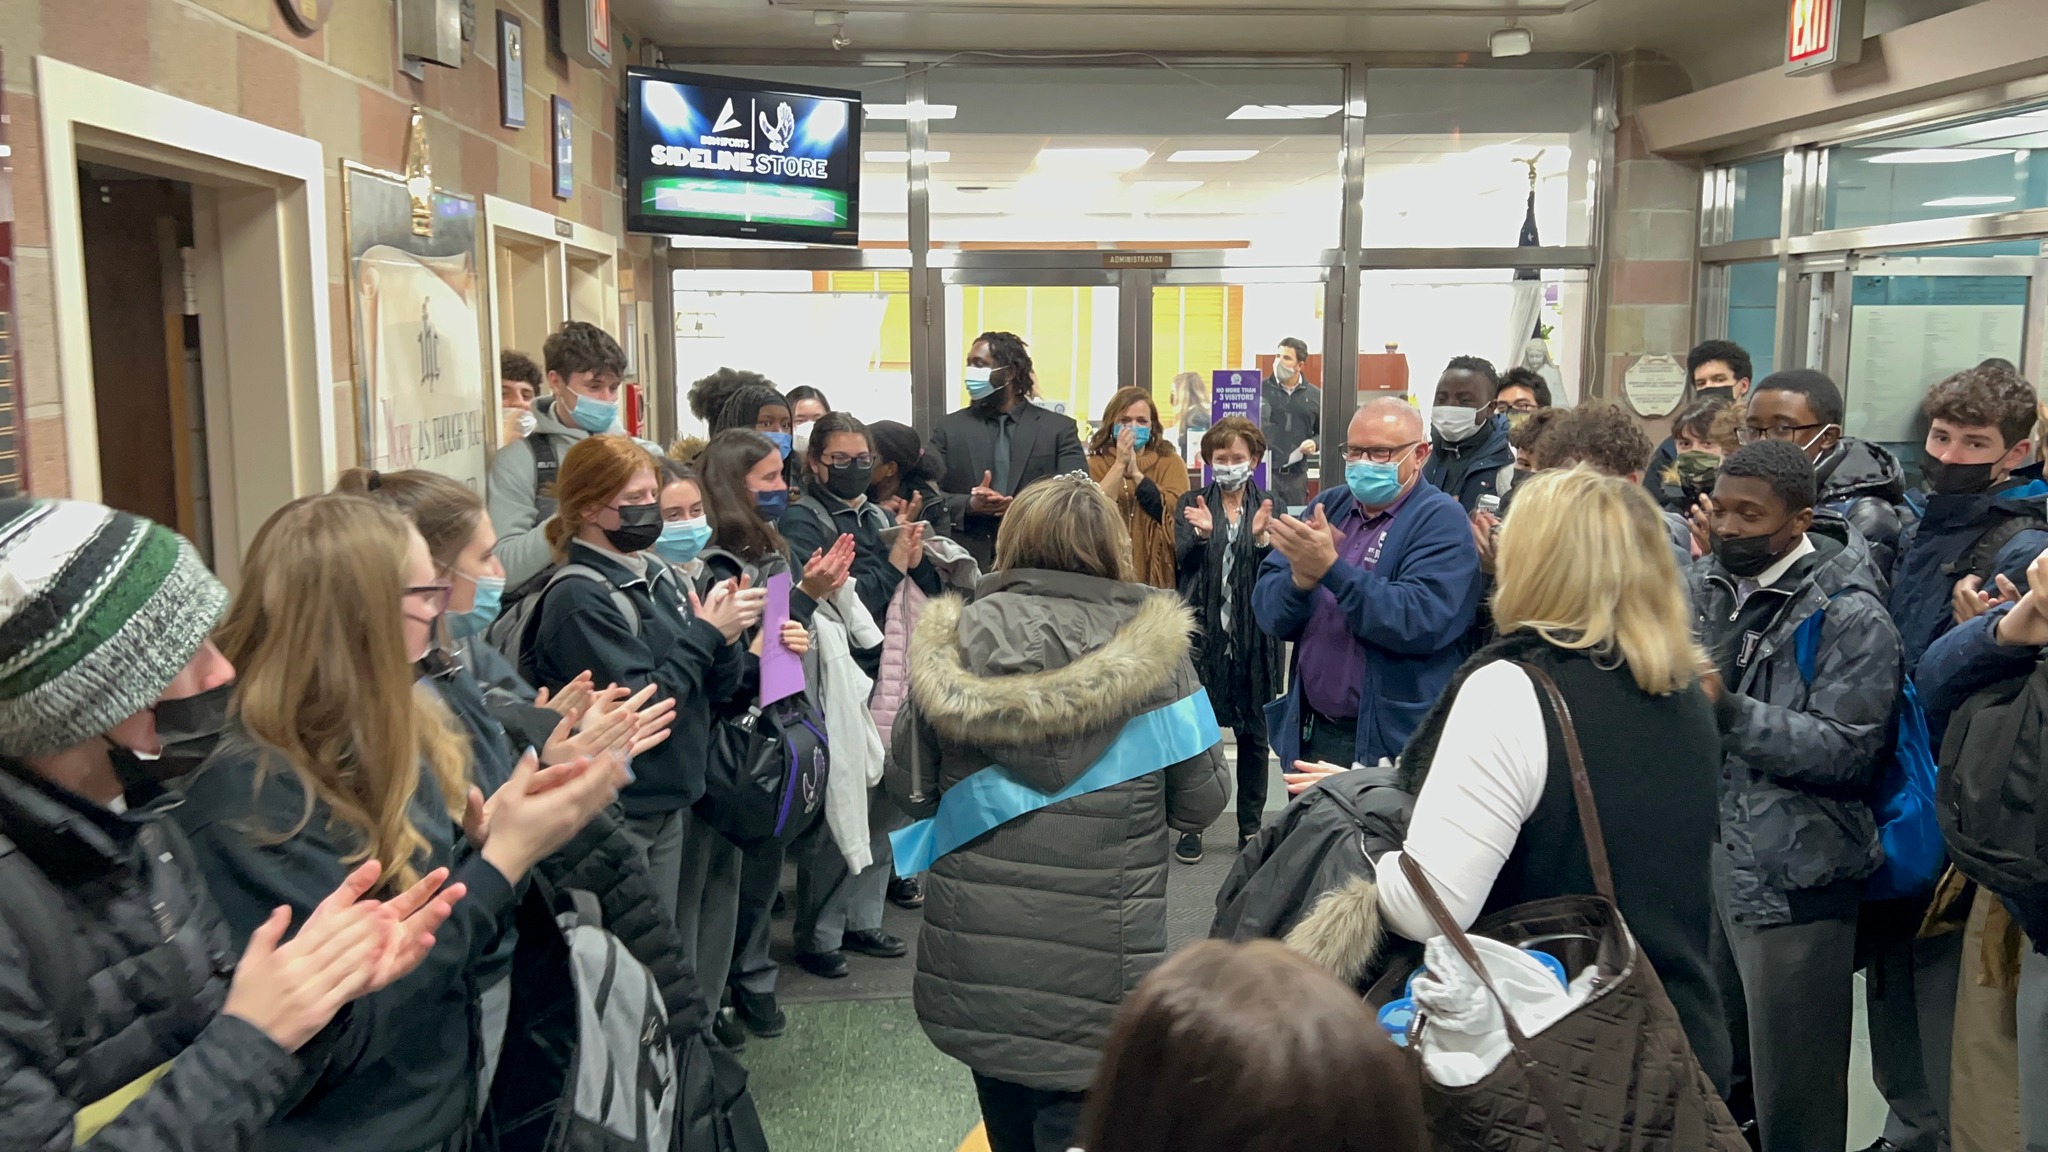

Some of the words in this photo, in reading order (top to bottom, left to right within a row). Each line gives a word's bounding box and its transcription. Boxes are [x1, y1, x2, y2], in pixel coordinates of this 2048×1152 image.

[651, 145, 754, 172] SIDELINE
[755, 154, 828, 179] STORE
[1110, 255, 1163, 263] ADMINISTRATION
[1219, 393, 1224, 401] 3
[1225, 393, 1254, 401] VISITORS
[1223, 402, 1230, 410] IN
[1231, 402, 1247, 410] THIS
